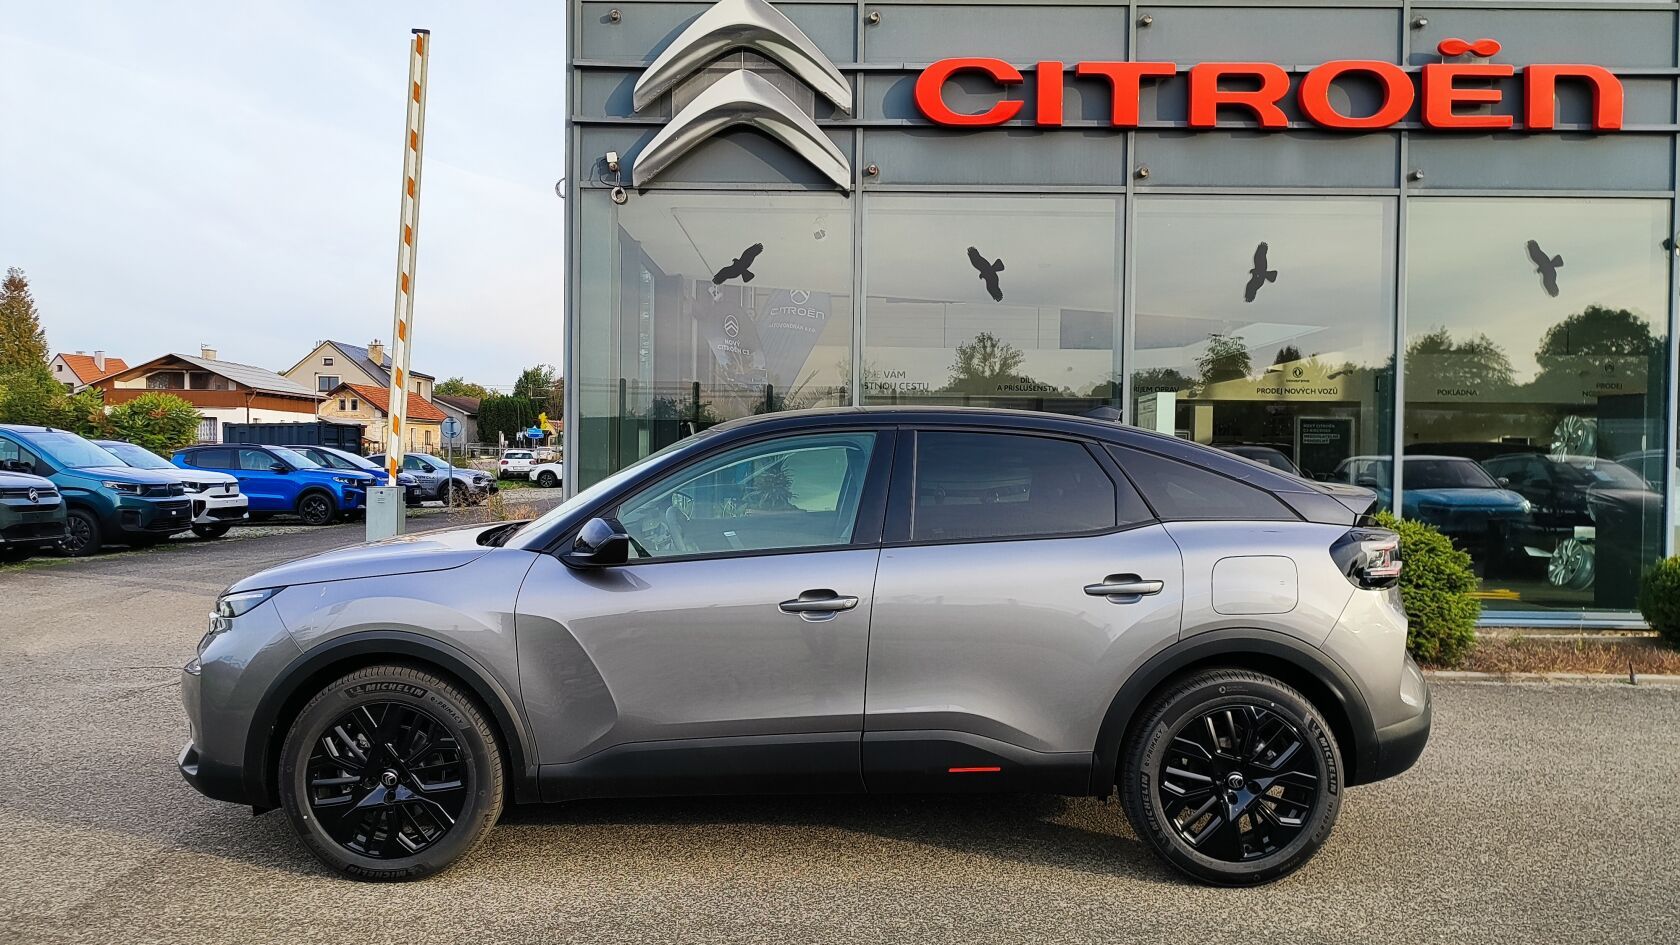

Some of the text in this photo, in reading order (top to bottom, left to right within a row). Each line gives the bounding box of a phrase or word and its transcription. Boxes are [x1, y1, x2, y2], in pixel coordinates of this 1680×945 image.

[914, 38, 1624, 132] CITROËN
[898, 382, 929, 391] CESTU
[1256, 386, 1338, 396] PRODEJ NOVÝCH VOZŮ
[1437, 388, 1478, 396] POKLADNA
[365, 682, 425, 698] MICHELIN
[1319, 736, 1337, 795] MICHELIN
[1141, 774, 1159, 832] MICHELIN
